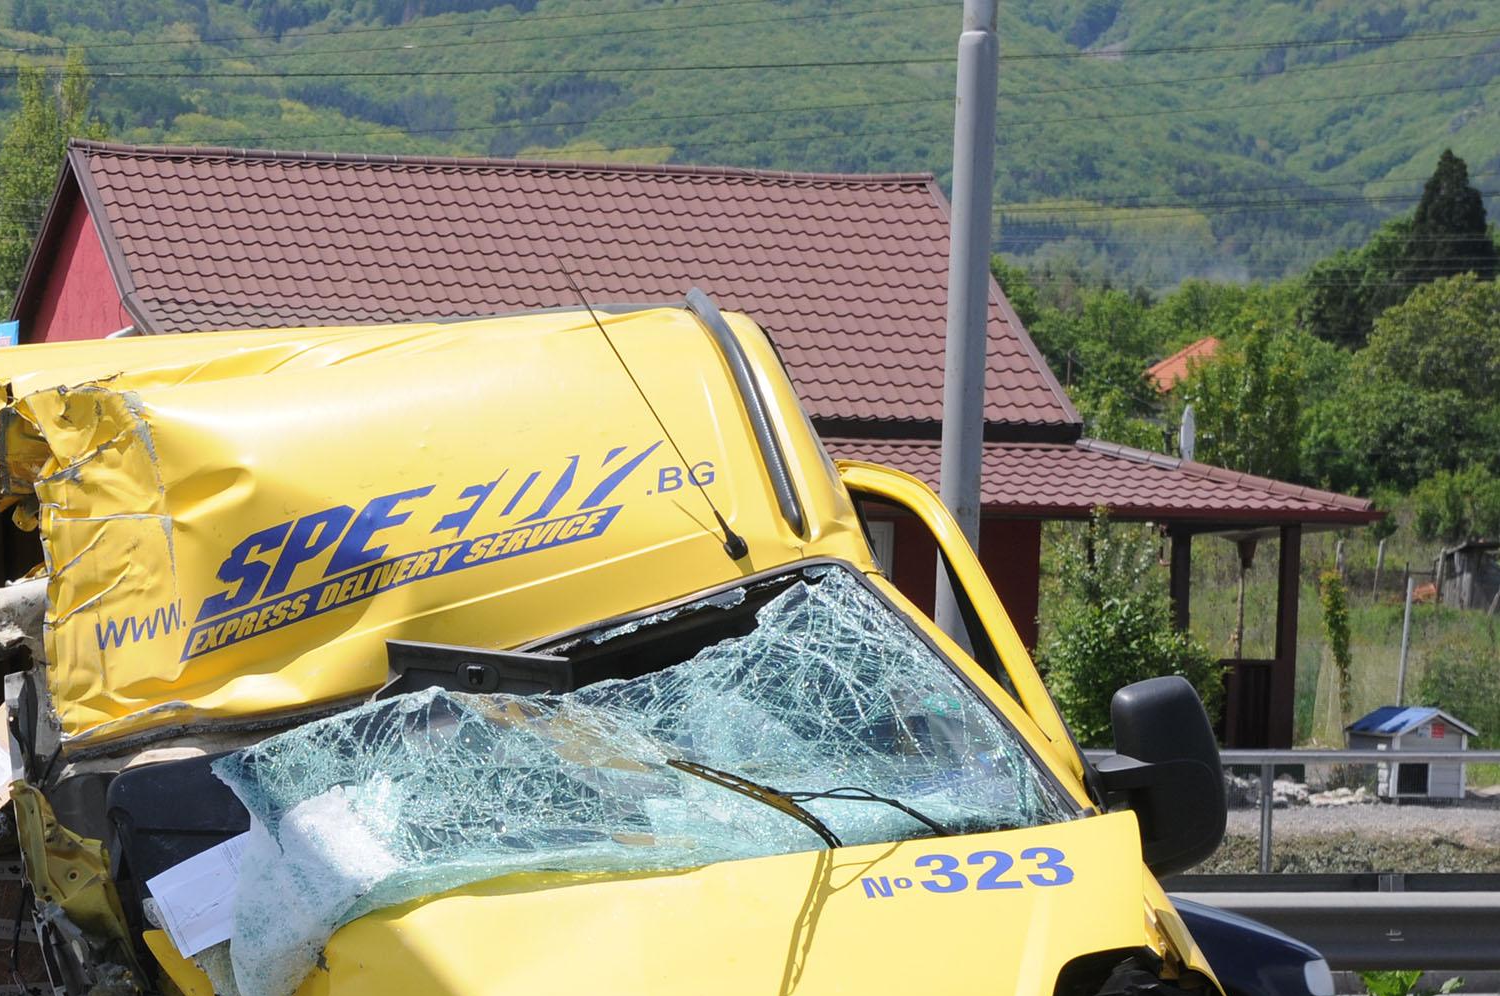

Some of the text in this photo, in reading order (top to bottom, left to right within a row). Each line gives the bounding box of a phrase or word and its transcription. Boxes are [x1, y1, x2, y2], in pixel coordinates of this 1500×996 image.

[188, 509, 607, 656] EXPRESS DELIVERY SERVICE
[914, 847, 1074, 894] 323
